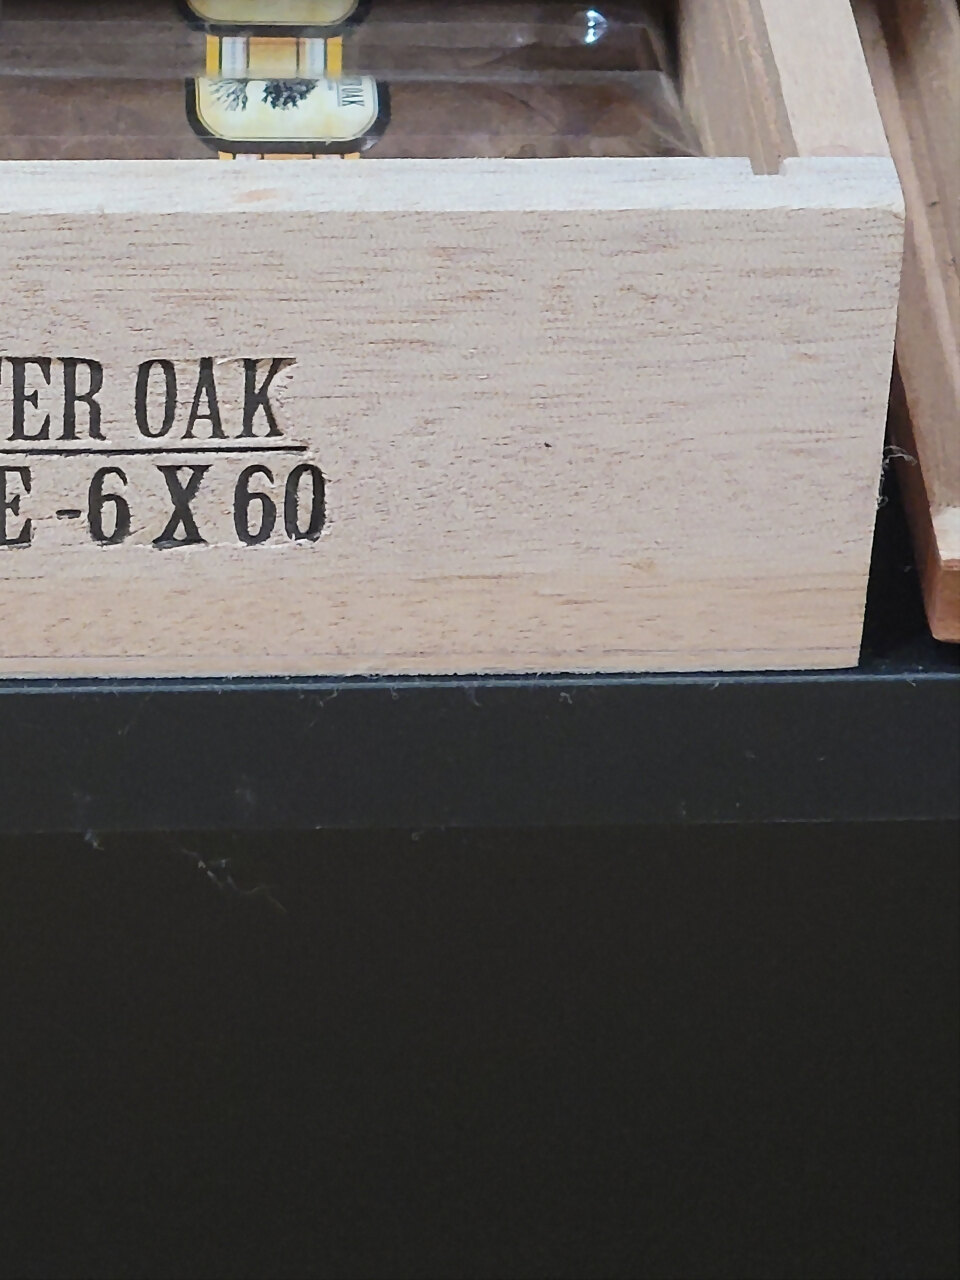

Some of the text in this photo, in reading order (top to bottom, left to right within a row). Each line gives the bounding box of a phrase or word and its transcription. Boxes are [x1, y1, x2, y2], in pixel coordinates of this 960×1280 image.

[134, 356, 296, 439] OAK
[152, 464, 213, 548] X
[233, 463, 327, 545] 60
